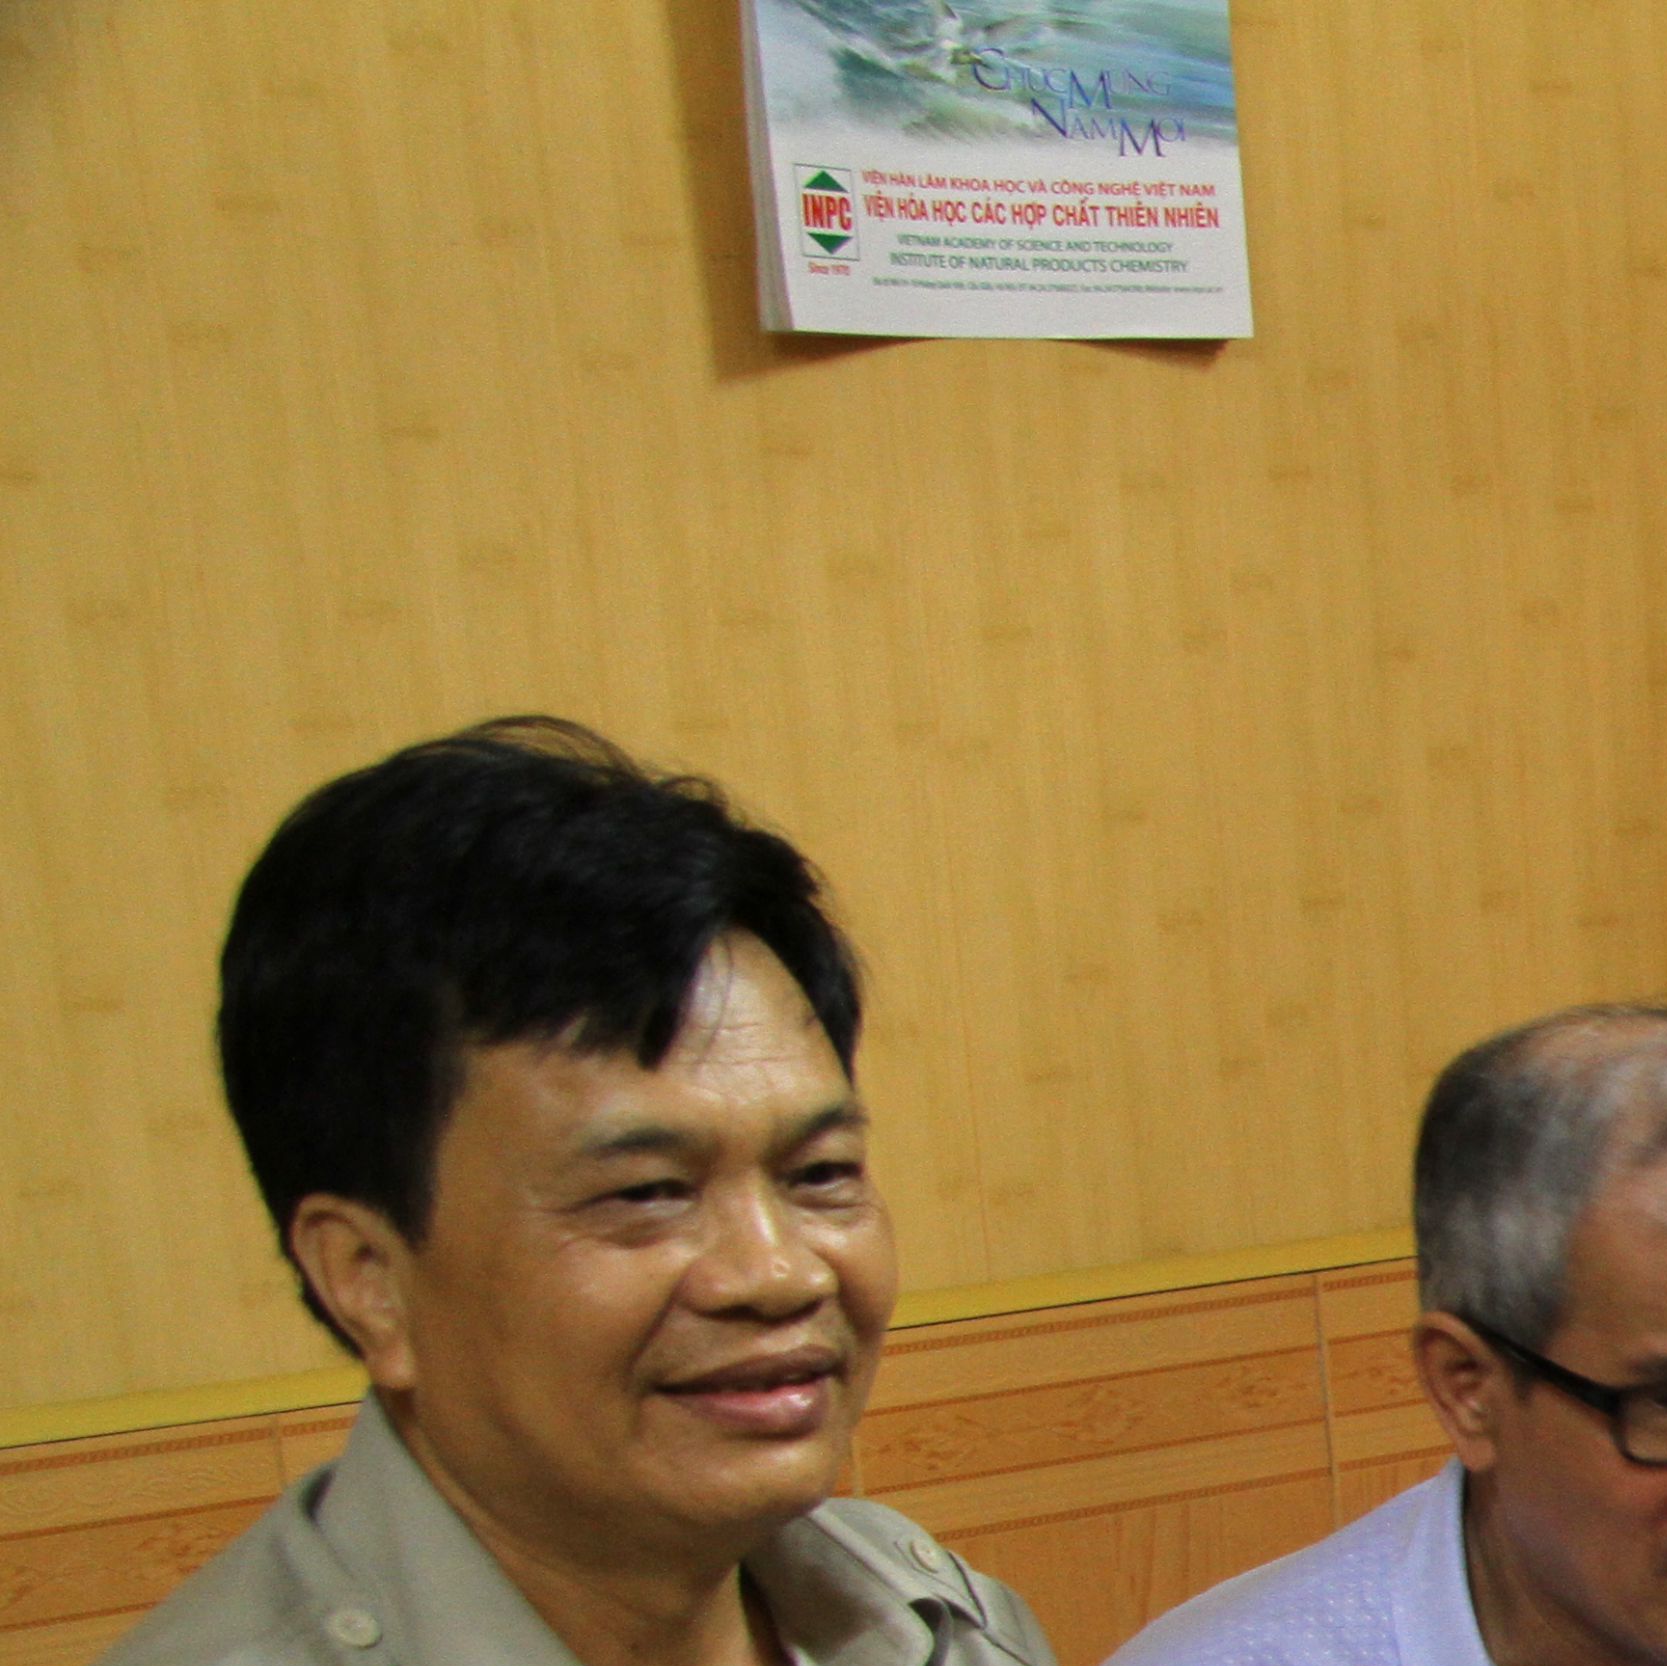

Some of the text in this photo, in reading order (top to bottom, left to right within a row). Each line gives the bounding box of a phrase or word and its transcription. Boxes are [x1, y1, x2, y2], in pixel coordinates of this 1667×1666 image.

[951, 176, 990, 192] KHOA
[1180, 185, 1215, 196] NAM
[802, 193, 853, 231] INPC
[863, 190, 895, 222] VIỆN
[932, 201, 967, 227] HỌC
[971, 197, 1006, 225] CÁC
[1011, 201, 1048, 230] HỢP
[1052, 196, 1101, 227] CHẤT
[1105, 202, 1158, 227] THIÊN
[1165, 203, 1219, 228] NHIÊN
[999, 238, 1015, 250] OF
[948, 255, 967, 269] OF
[969, 256, 1030, 271] NATURAL
[1033, 257, 1108, 273] PRODUCTS
[1110, 258, 1189, 274] CHEMISTRY
